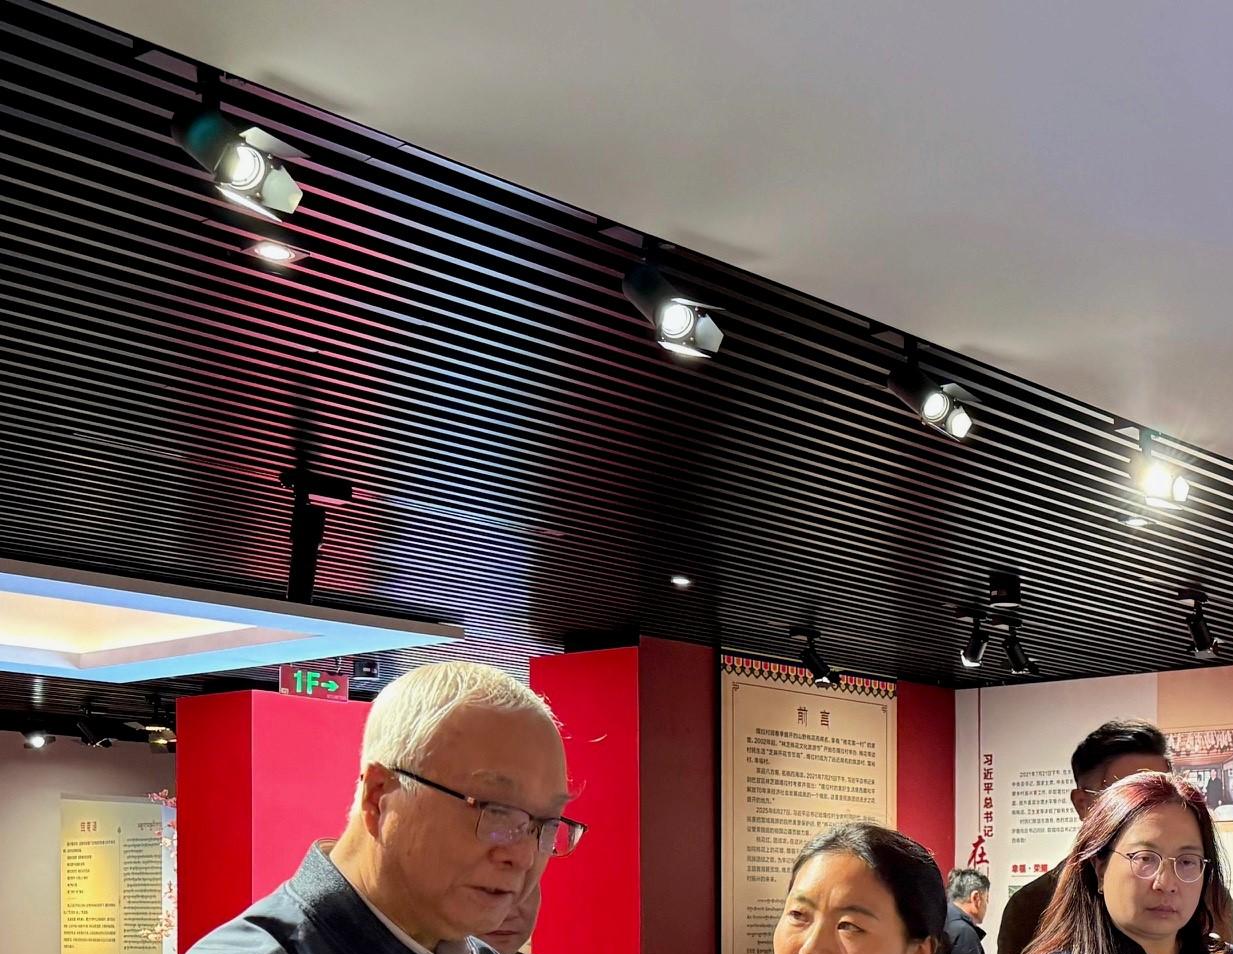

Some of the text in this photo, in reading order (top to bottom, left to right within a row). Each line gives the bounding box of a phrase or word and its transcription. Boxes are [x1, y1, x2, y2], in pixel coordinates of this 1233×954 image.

[293, 670, 320, 694] 1F
[983, 753, 993, 837] 习近平总书记
[967, 835, 989, 869] 在
